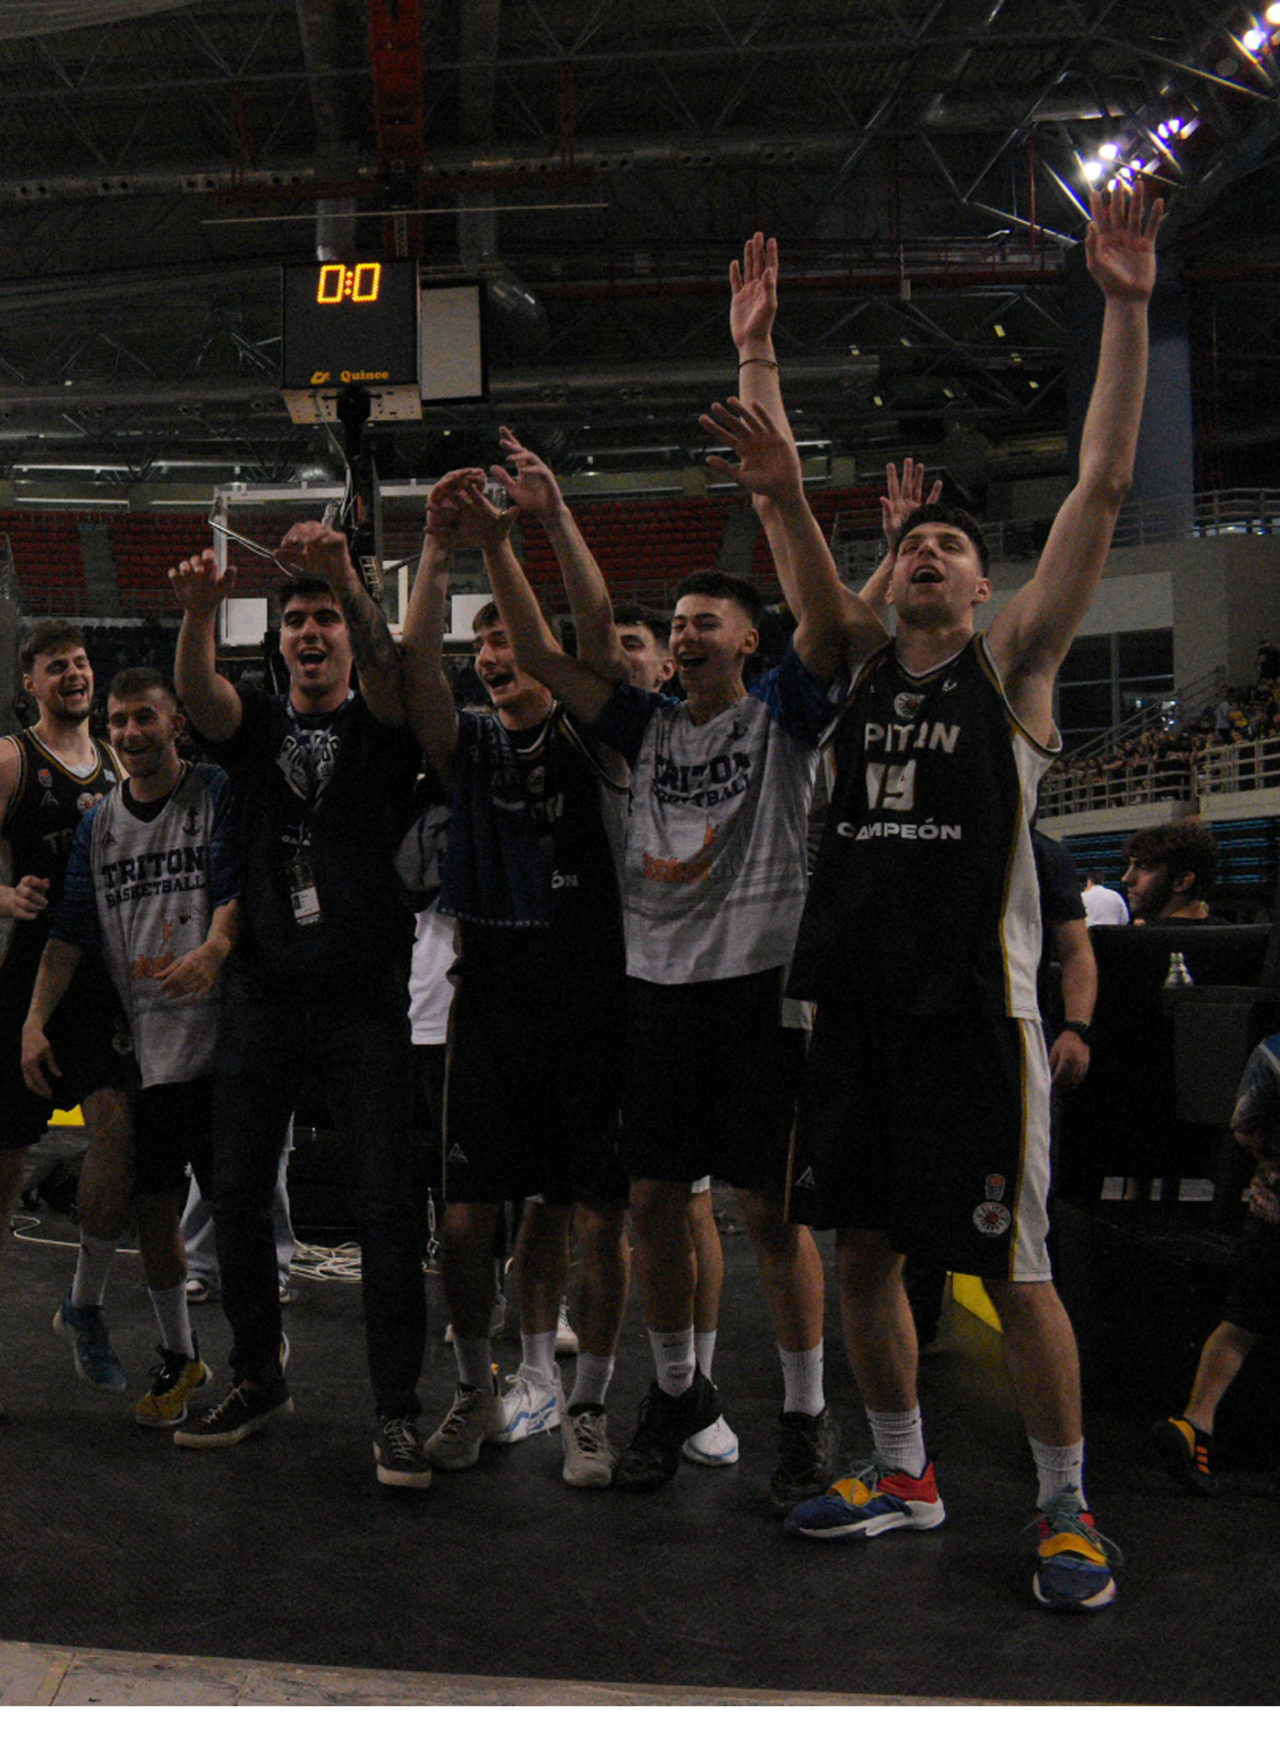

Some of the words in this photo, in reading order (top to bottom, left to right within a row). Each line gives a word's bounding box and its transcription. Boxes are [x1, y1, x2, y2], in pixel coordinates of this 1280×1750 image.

[340, 370, 390, 383] Quince
[102, 847, 207, 889] TRITON
[106, 875, 206, 908] BASKETBALL
